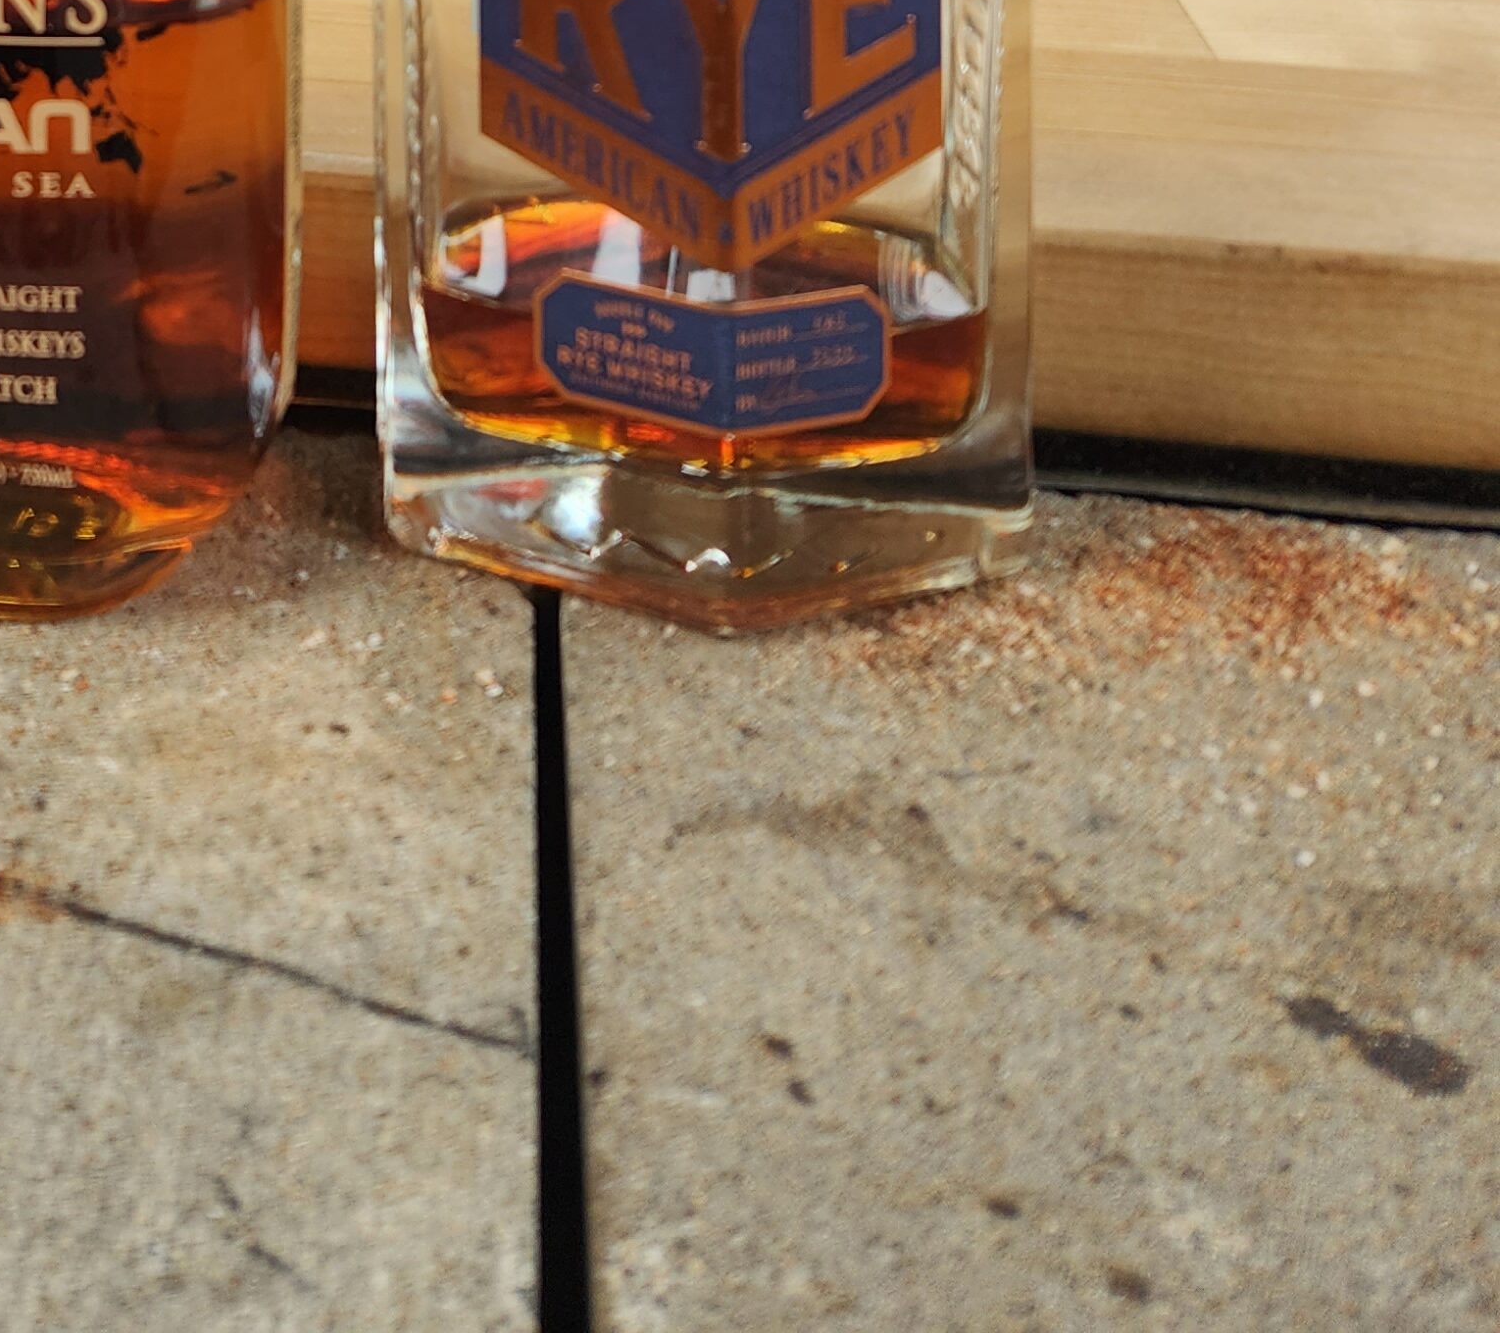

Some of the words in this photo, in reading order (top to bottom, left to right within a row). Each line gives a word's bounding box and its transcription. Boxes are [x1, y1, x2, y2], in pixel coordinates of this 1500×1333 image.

[10, 169, 98, 200] SEA
[503, 88, 701, 243] AMERICAN
[747, 105, 916, 245] WHISKEY
[575, 326, 692, 373] STRAIGHT
